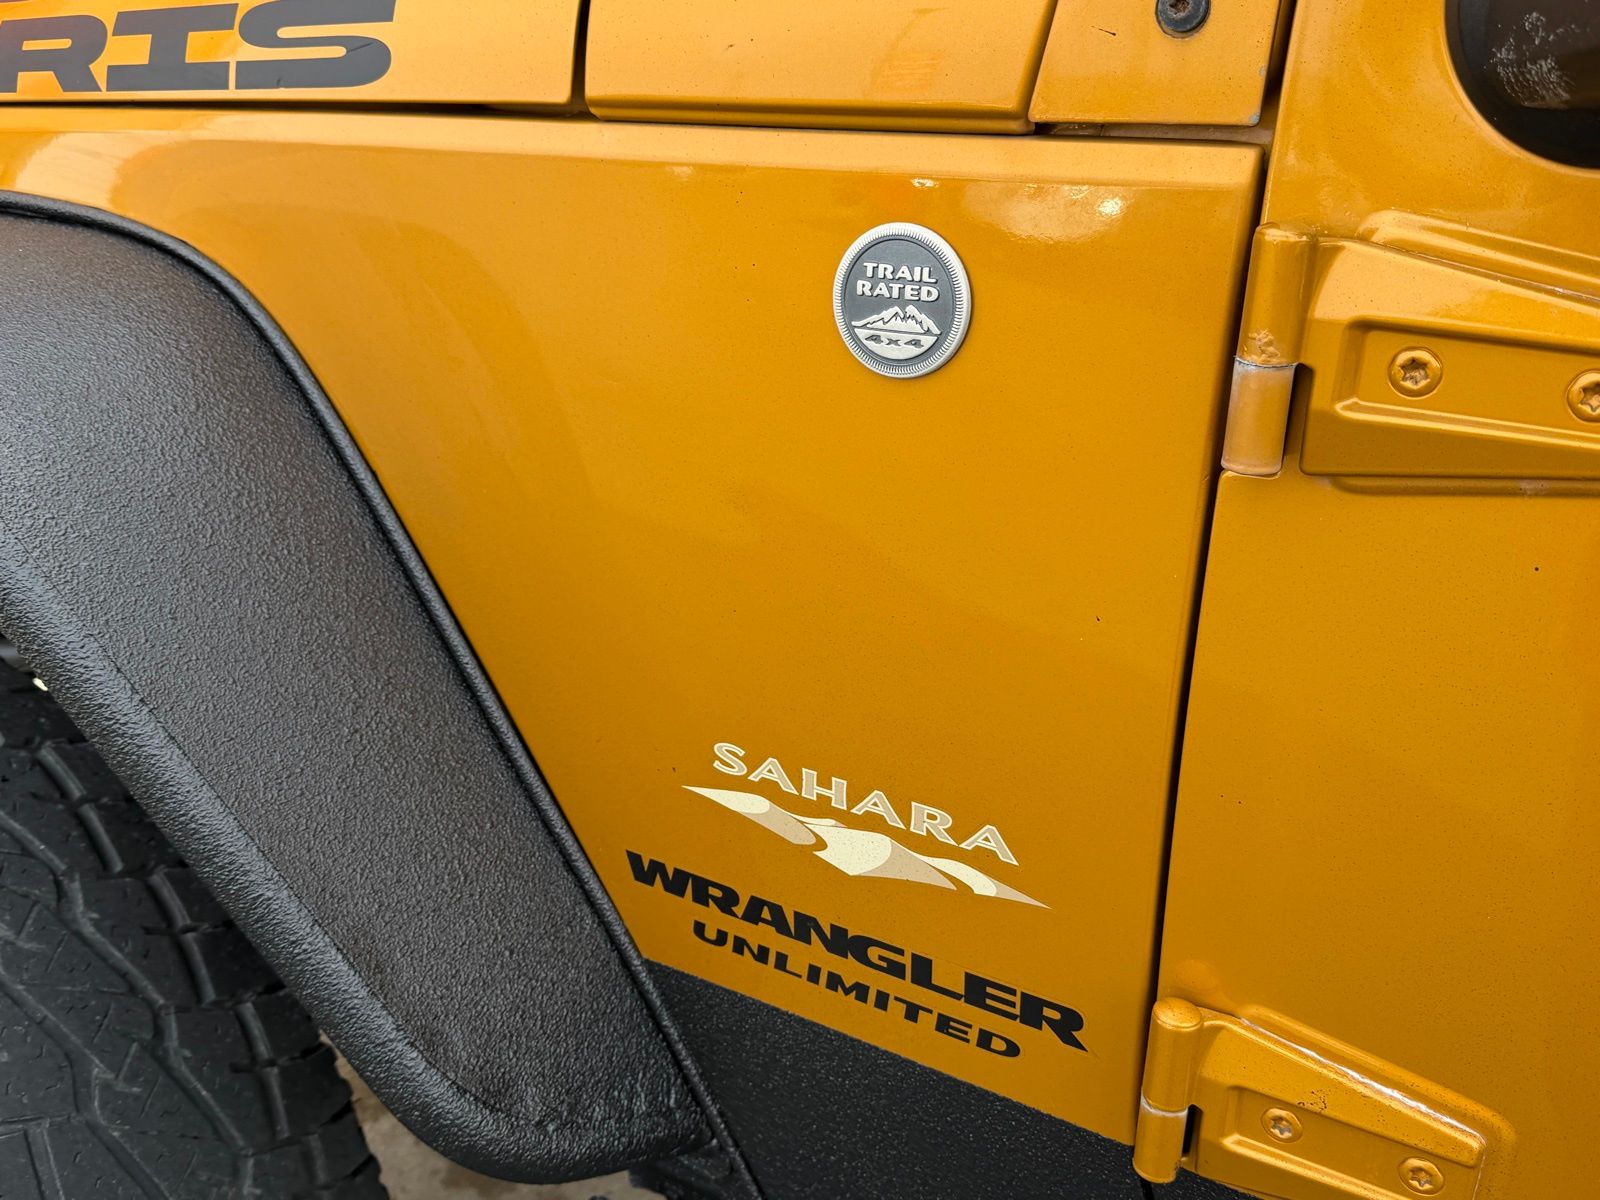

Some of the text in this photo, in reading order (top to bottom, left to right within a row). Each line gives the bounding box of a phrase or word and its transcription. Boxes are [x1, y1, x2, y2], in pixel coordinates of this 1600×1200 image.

[856, 280, 939, 302] RATED
[863, 262, 938, 283] TRAIL
[713, 742, 1019, 866] SAHARA
[625, 849, 1089, 1053] WRANGLER
[692, 920, 1021, 1058] UNLIMITED
